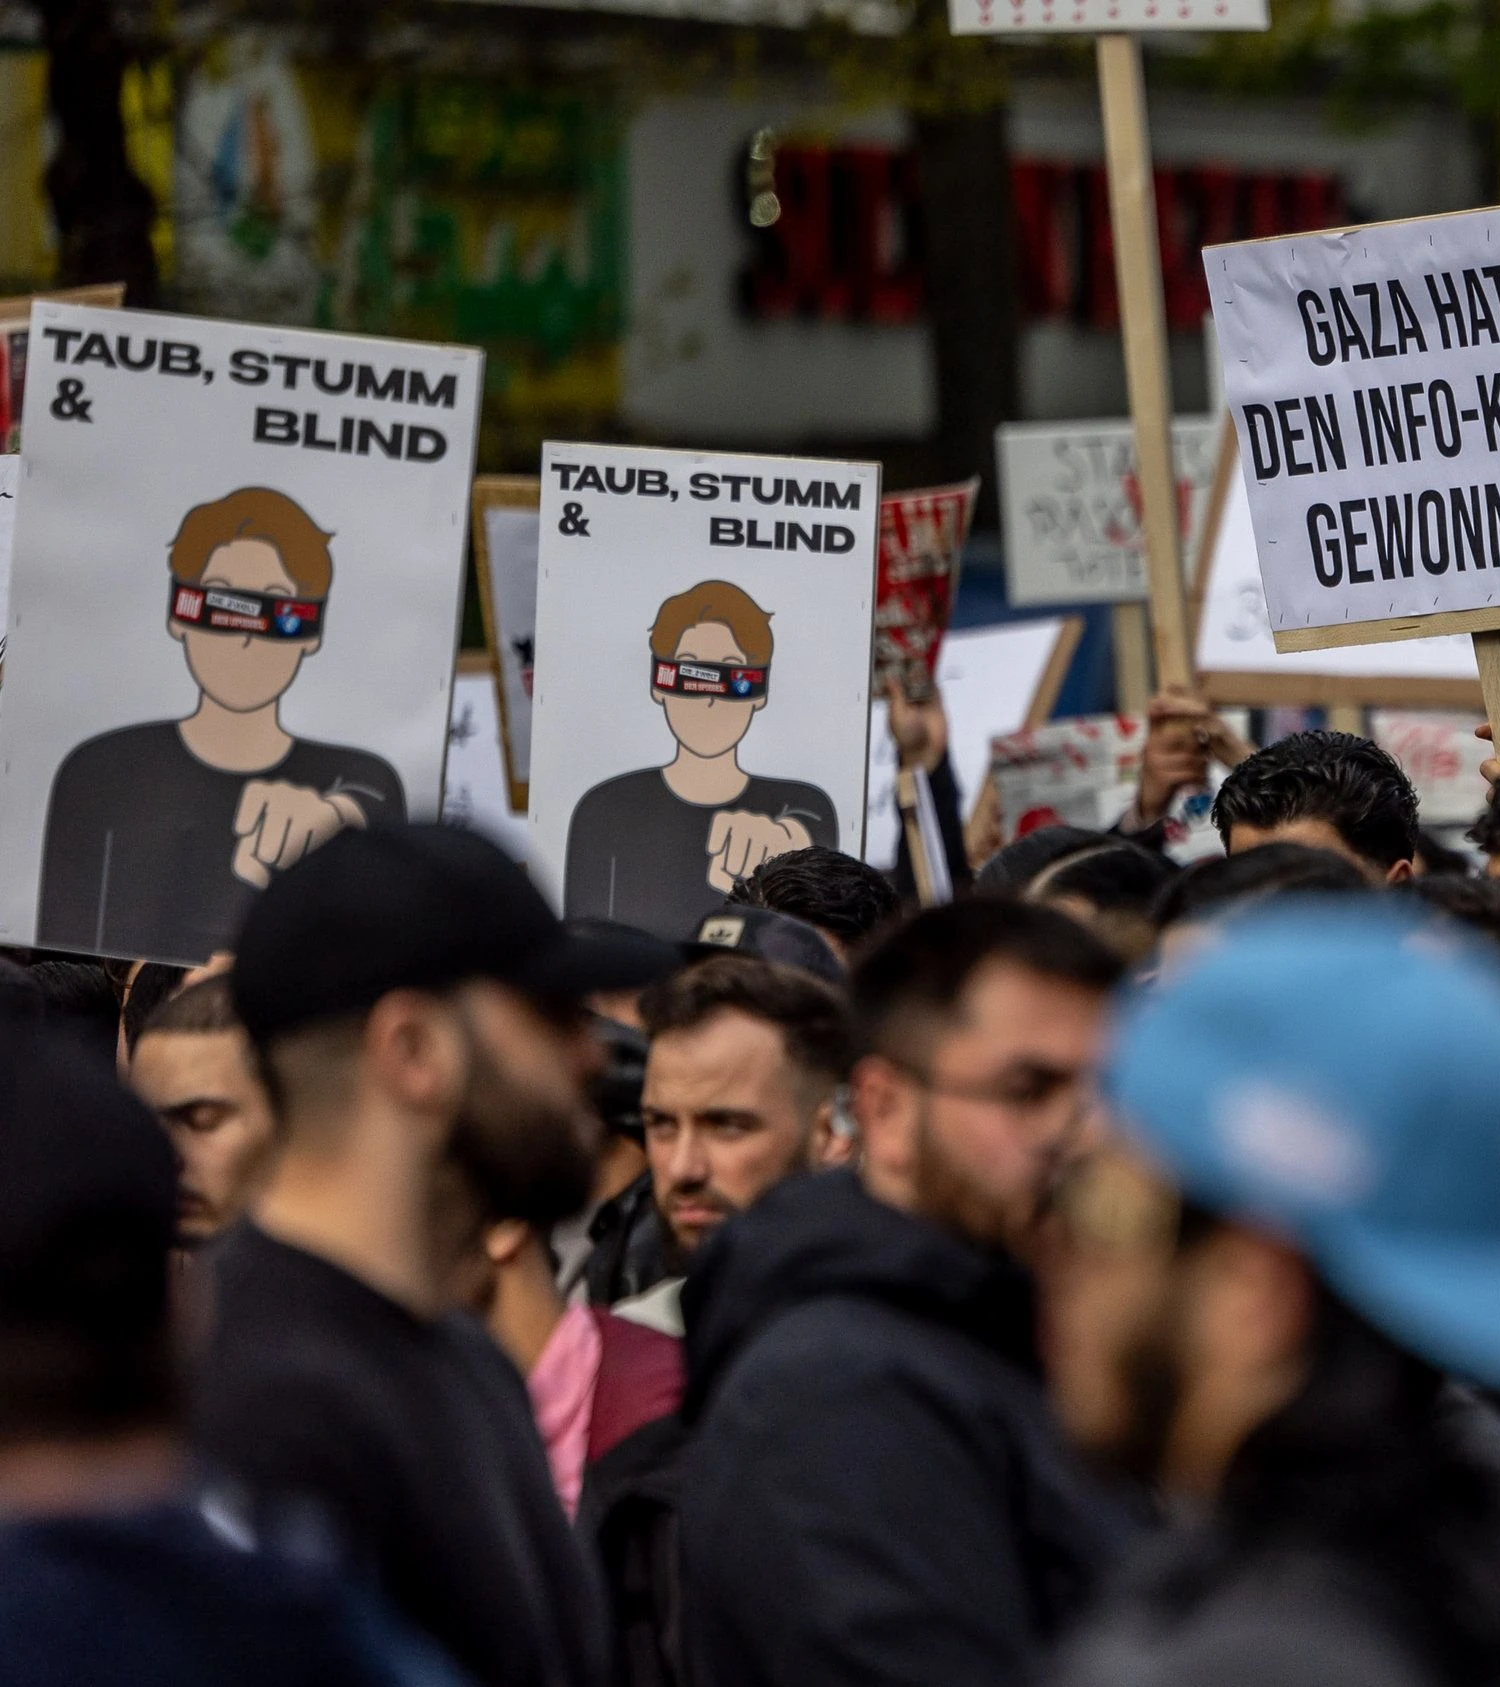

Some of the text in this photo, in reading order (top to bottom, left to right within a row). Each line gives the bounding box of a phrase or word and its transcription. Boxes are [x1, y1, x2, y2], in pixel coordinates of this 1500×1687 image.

[1295, 278, 1430, 367] GAZA
[43, 326, 458, 410] TAUB, STUMM
[49, 376, 448, 464] & BLIND
[1240, 397, 1348, 481] DEN
[550, 462, 861, 511] TAUB, STUMM
[557, 500, 857, 555] & BLIND
